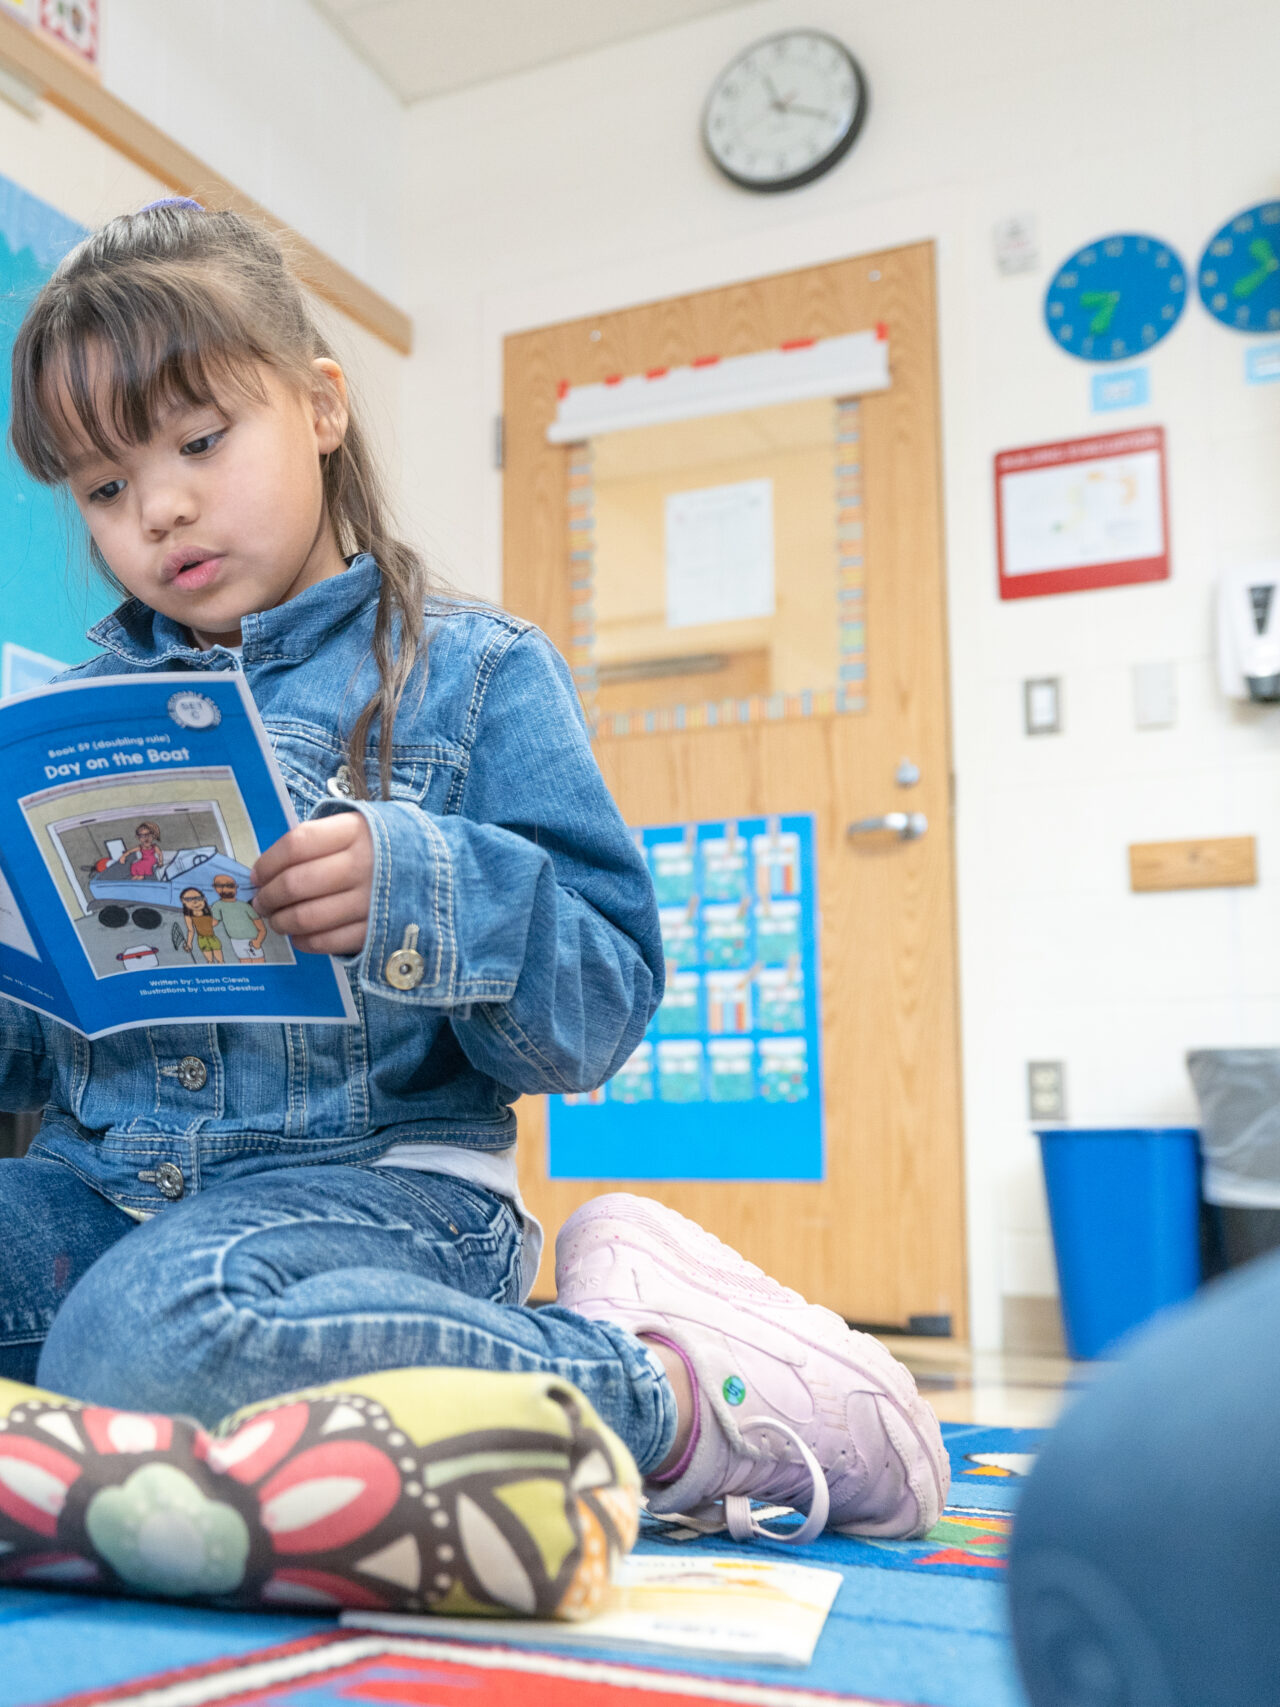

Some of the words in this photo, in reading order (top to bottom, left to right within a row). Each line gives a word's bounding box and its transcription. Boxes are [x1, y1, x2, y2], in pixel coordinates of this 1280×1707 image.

[48, 746, 76, 759] Book
[77, 742, 90, 752] 59
[92, 737, 145, 750] (doubling
[145, 734, 171, 745] rule)
[44, 762, 81, 779] Day
[86, 756, 109, 770] on
[112, 752, 143, 766] the
[146, 747, 190, 763] Boat
[139, 985, 186, 996] Illustrations
[203, 984, 227, 993] Laura
[149, 978, 179, 987] Written
[195, 977, 221, 985] Susan
